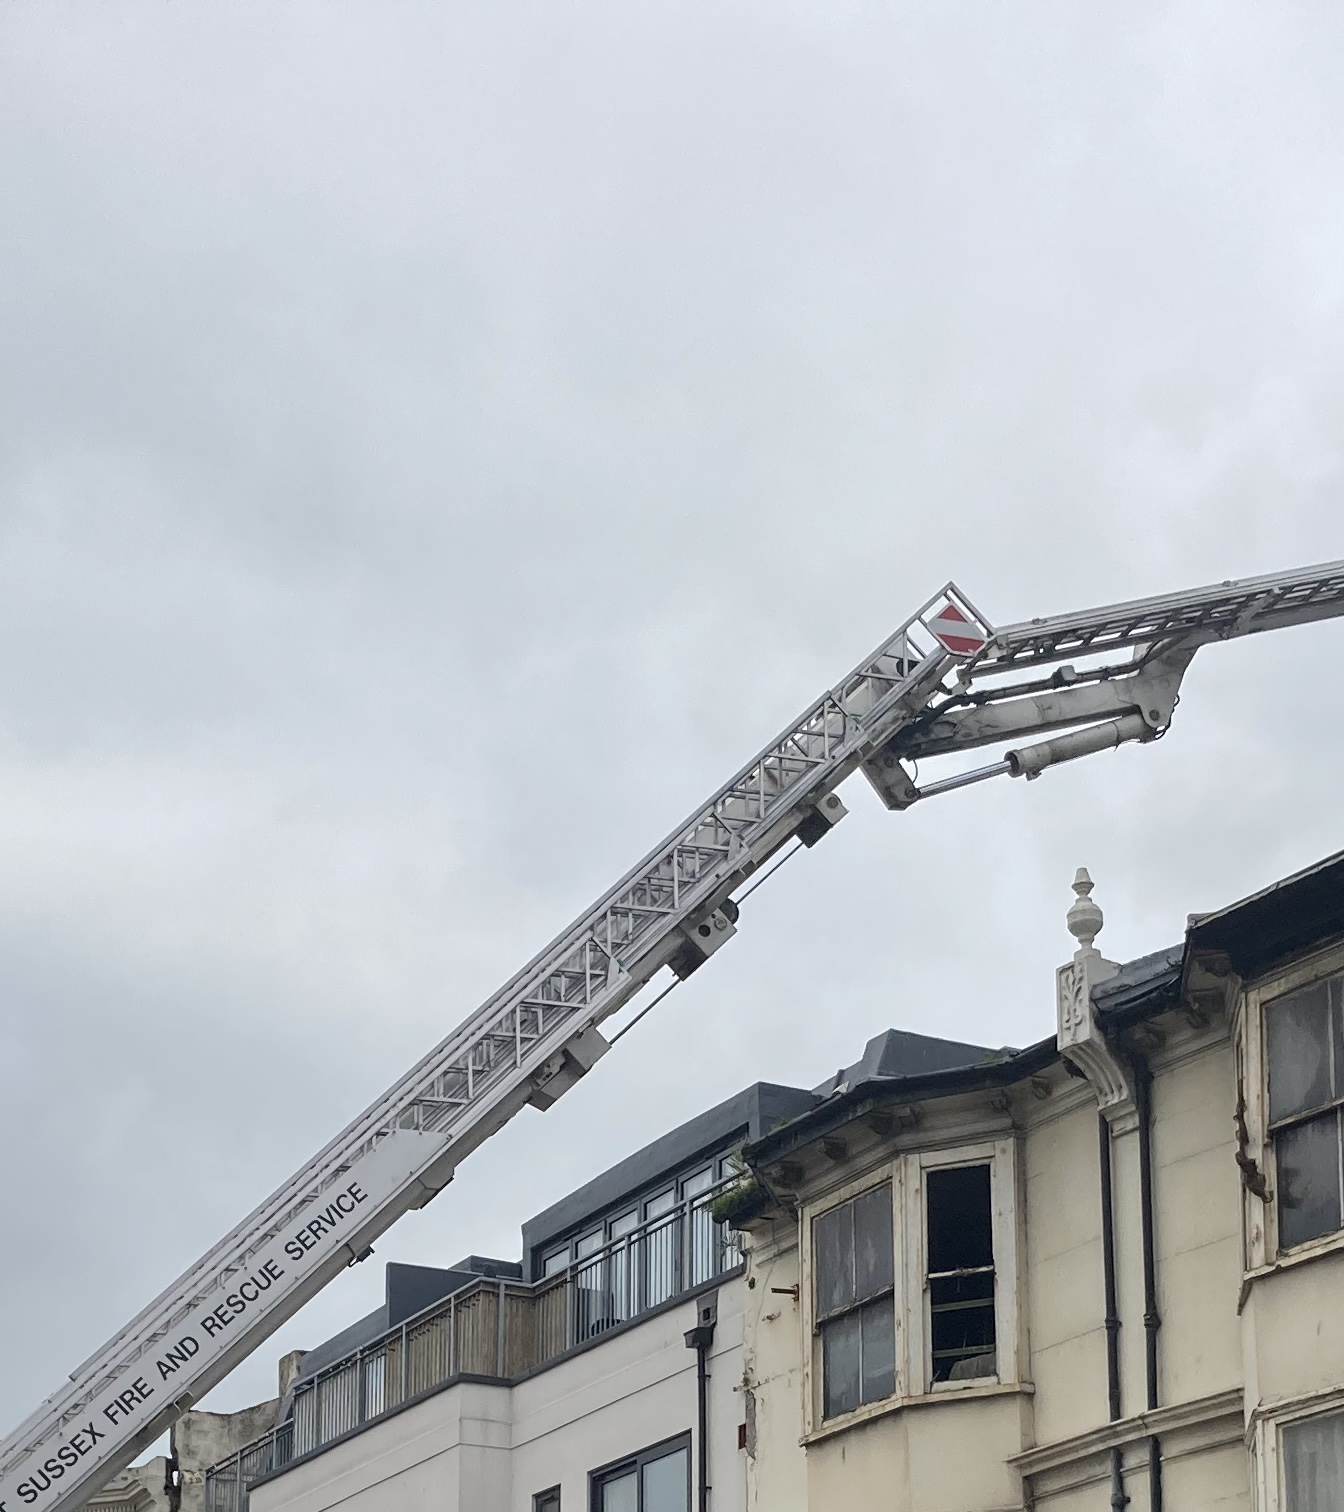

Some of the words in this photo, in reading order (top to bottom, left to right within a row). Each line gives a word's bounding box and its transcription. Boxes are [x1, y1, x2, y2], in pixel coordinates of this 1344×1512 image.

[17, 1422, 106, 1505] SUSSEX
[103, 1376, 155, 1426] FIRE
[155, 1335, 200, 1381] AND
[200, 1258, 285, 1338] RESCUE
[284, 1182, 368, 1262] SERVICE
